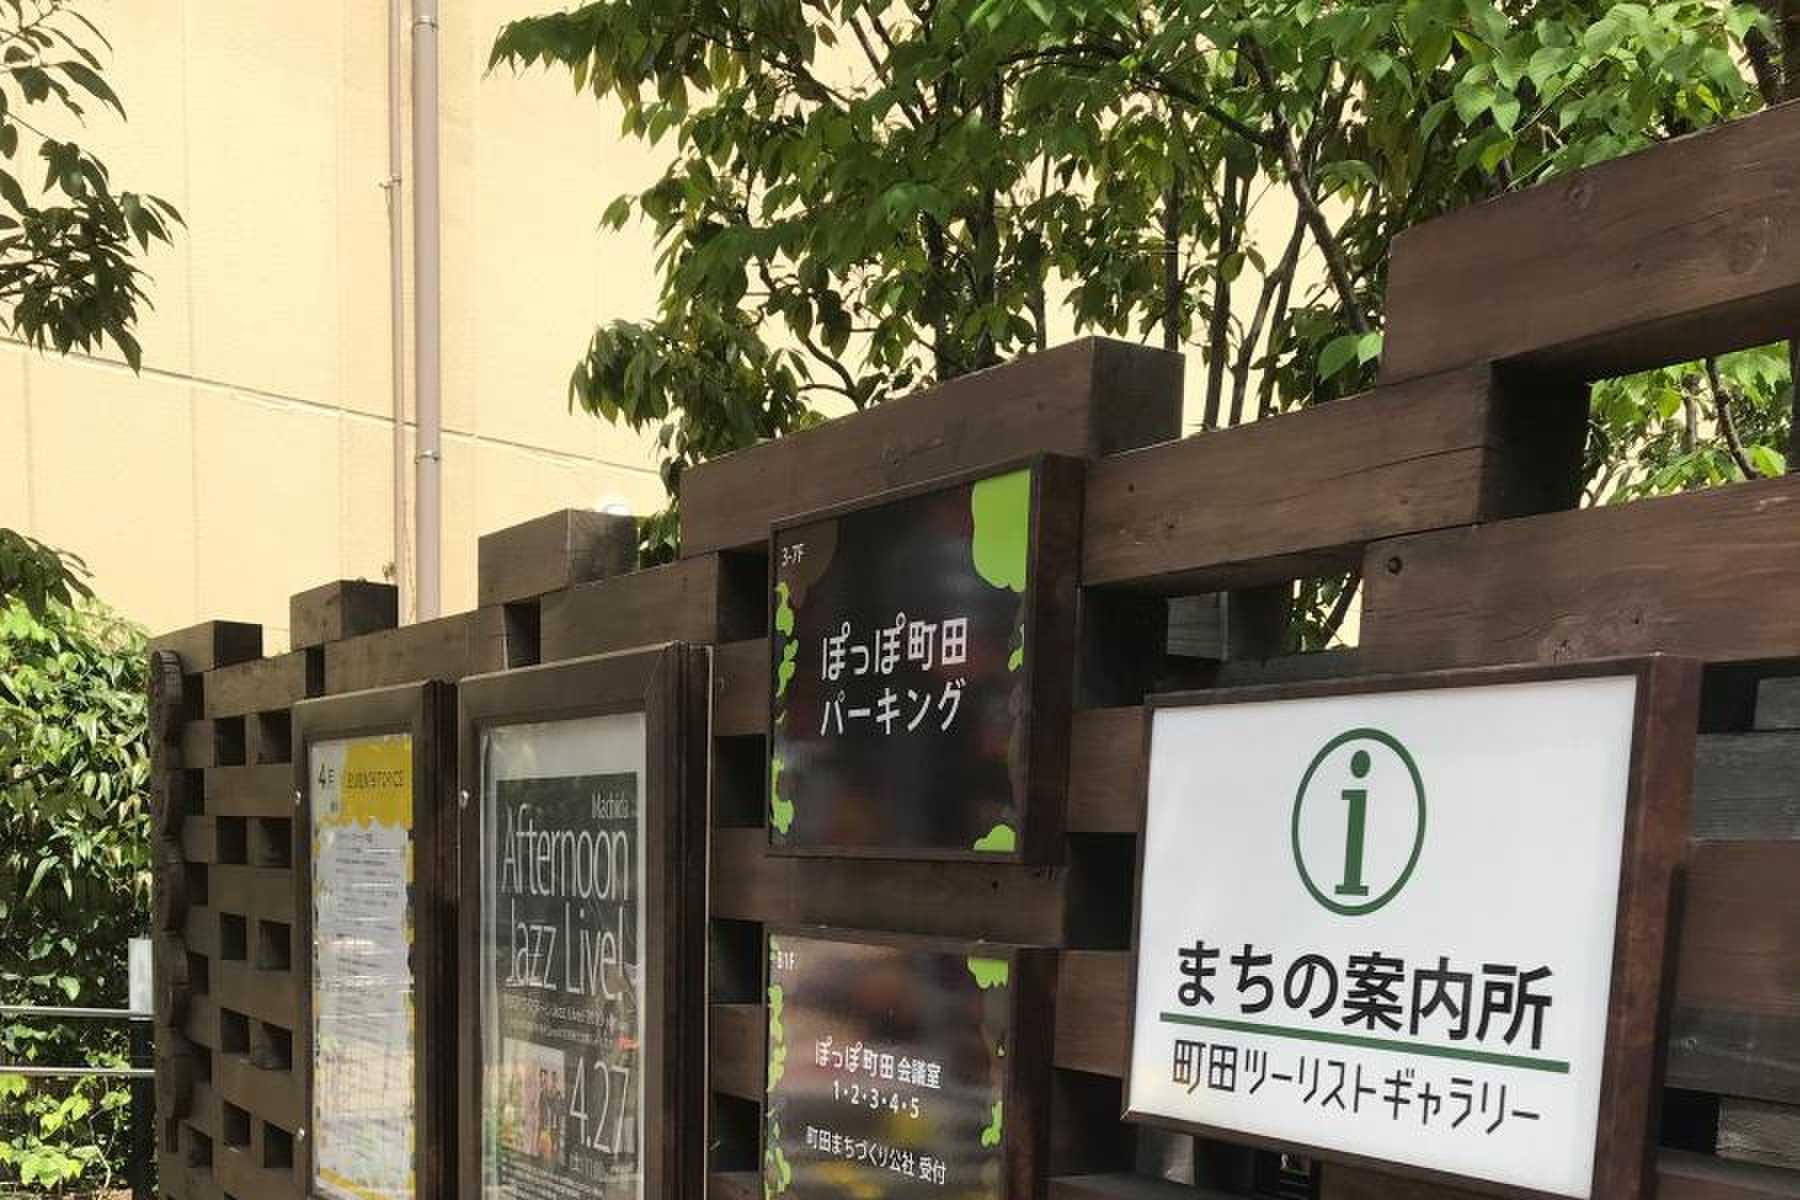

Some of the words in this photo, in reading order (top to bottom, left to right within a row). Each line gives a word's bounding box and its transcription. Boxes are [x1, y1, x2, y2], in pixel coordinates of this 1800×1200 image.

[821, 612, 967, 680] ぽっぽ町田
[820, 678, 966, 736] パーキング
[501, 803, 629, 900] Afternoon
[505, 898, 557, 990] Jazz
[1177, 941, 1554, 1050] まちの案内所
[569, 1055, 631, 1156] 4.27
[815, 1035, 894, 1079] ぽっぽ町田
[897, 1056, 942, 1089] 会議室
[1171, 1039, 1541, 1135] 町田ツーリストギャラリー
[805, 1125, 915, 1177] 町田まちづくり公社
[918, 1156, 947, 1185] 受付
